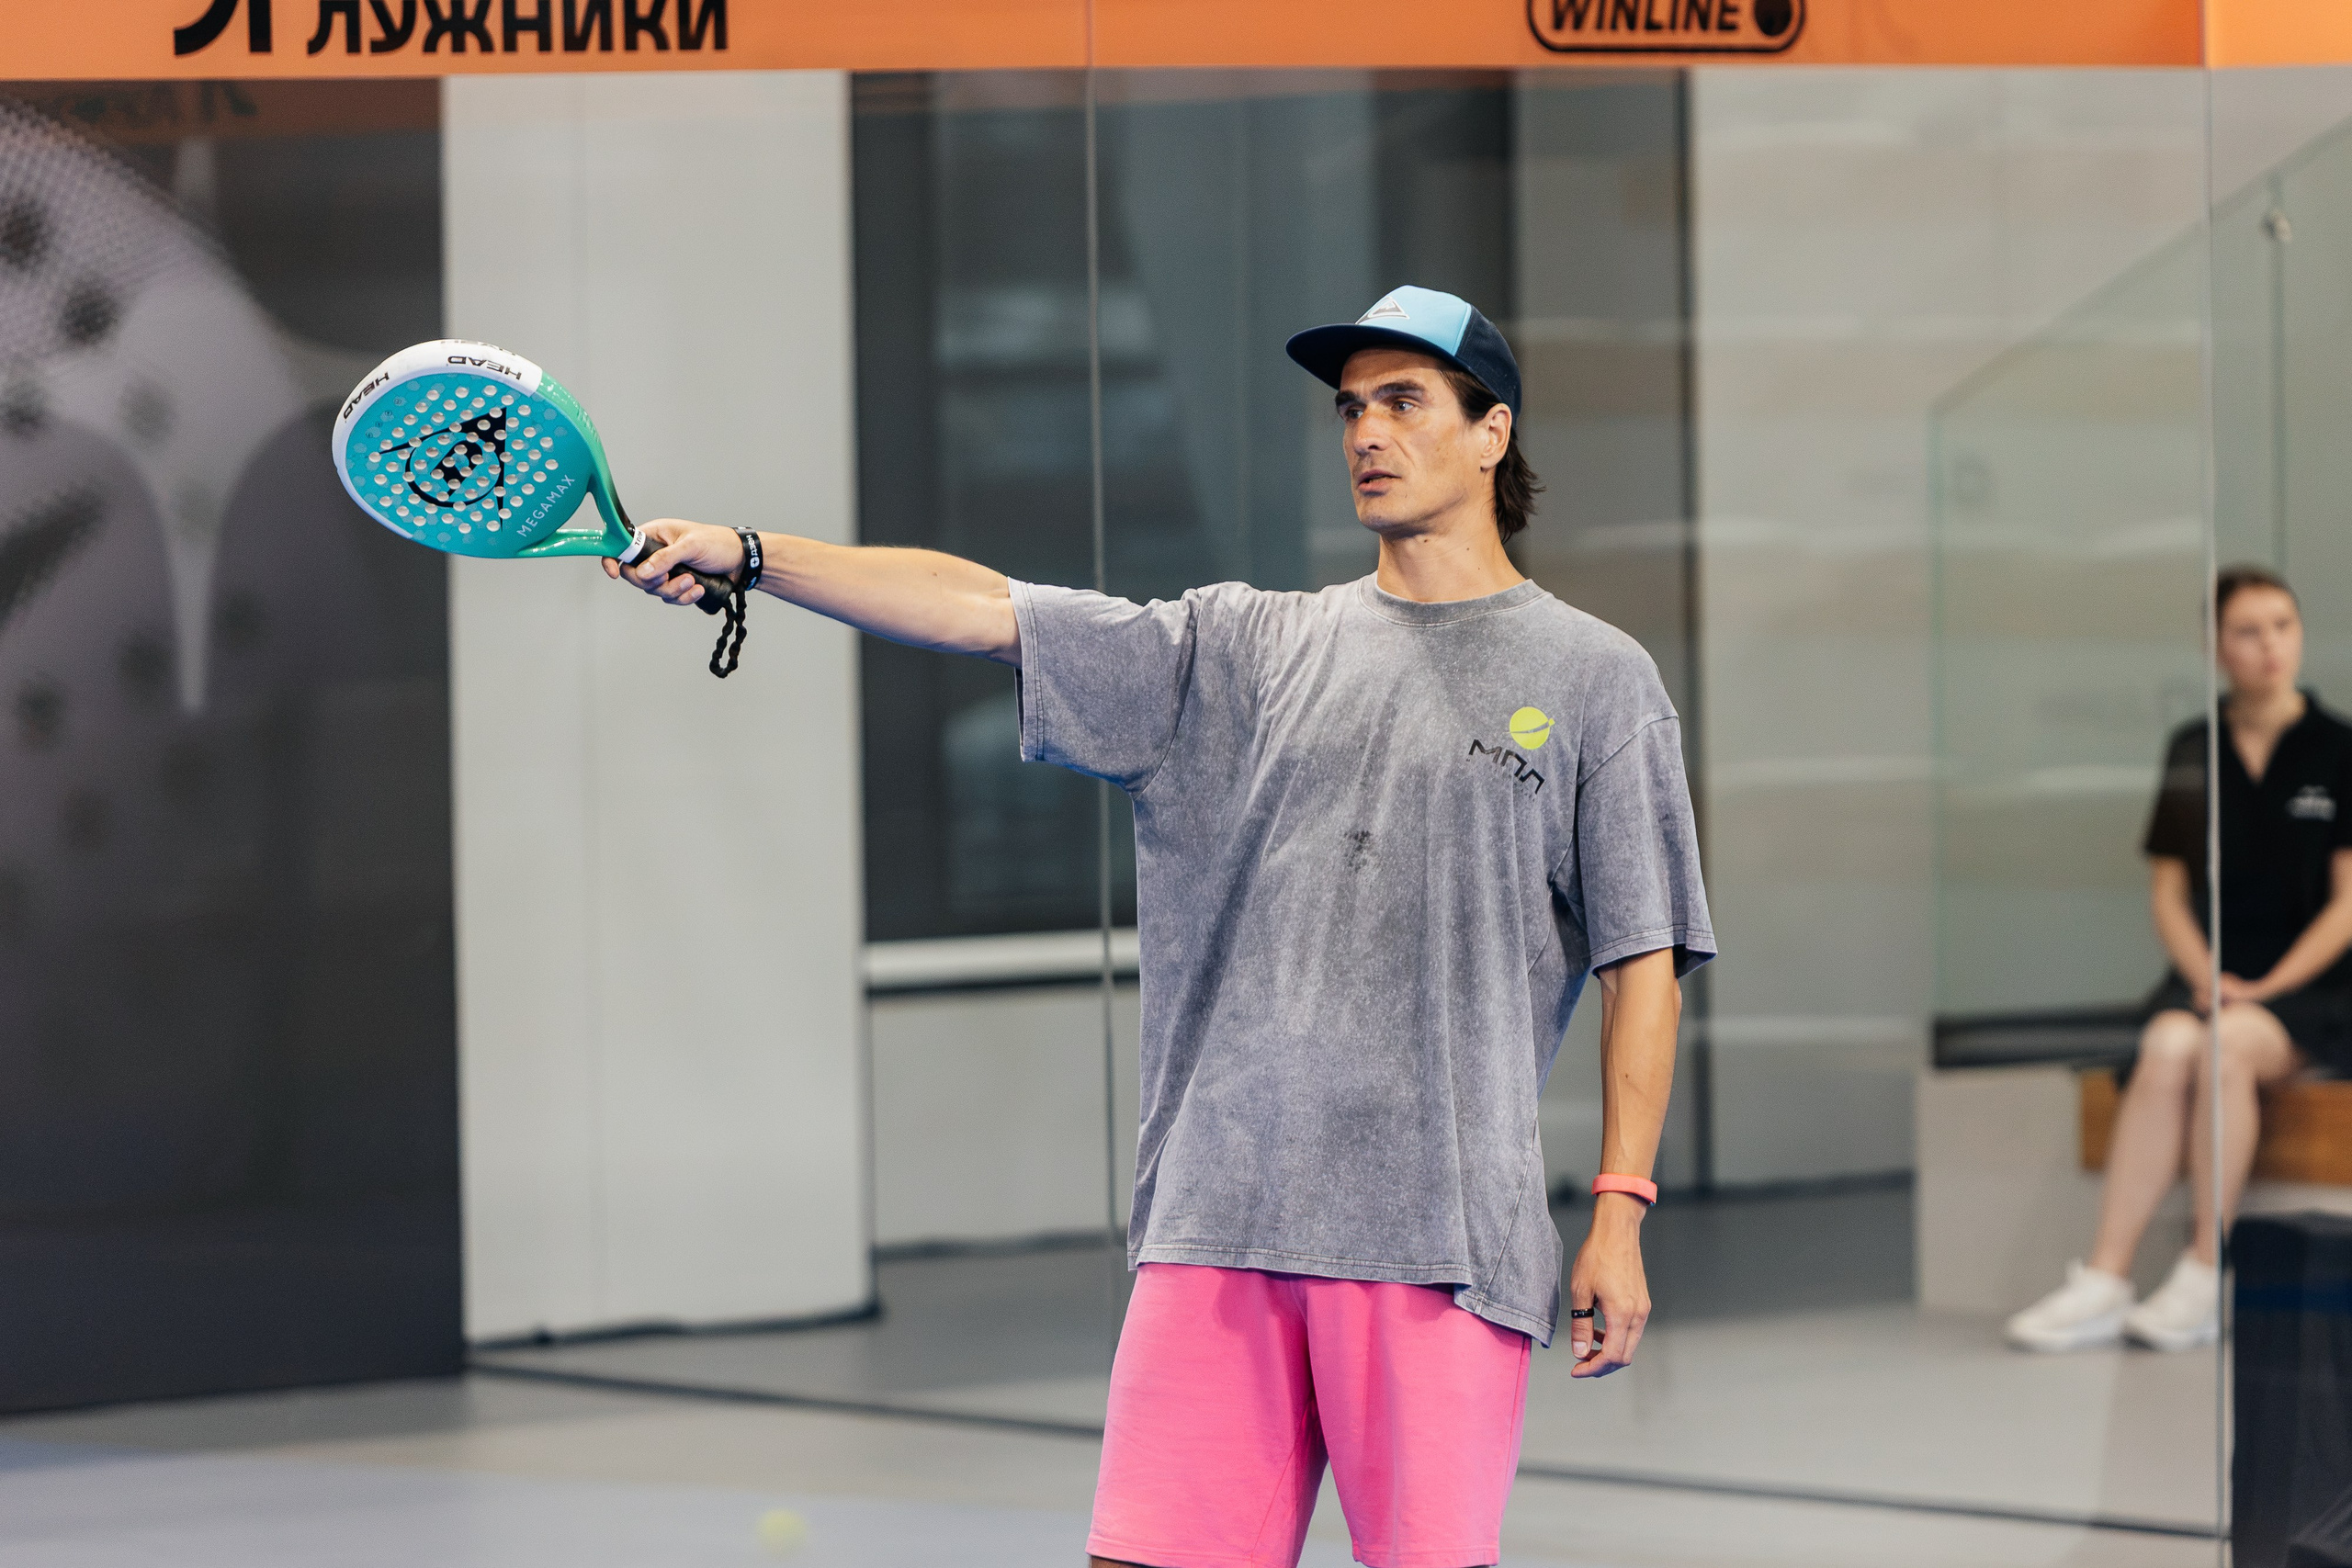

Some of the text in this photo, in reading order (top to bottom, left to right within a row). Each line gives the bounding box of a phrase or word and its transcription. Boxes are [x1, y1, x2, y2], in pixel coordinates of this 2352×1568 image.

[307, 0, 729, 54] ЛУЖНИКИ
[1551, 0, 1740, 31] WINLINE
[447, 355, 522, 380] HEAD
[344, 371, 390, 420] HEAD
[516, 474, 576, 537] MEGAMAX
